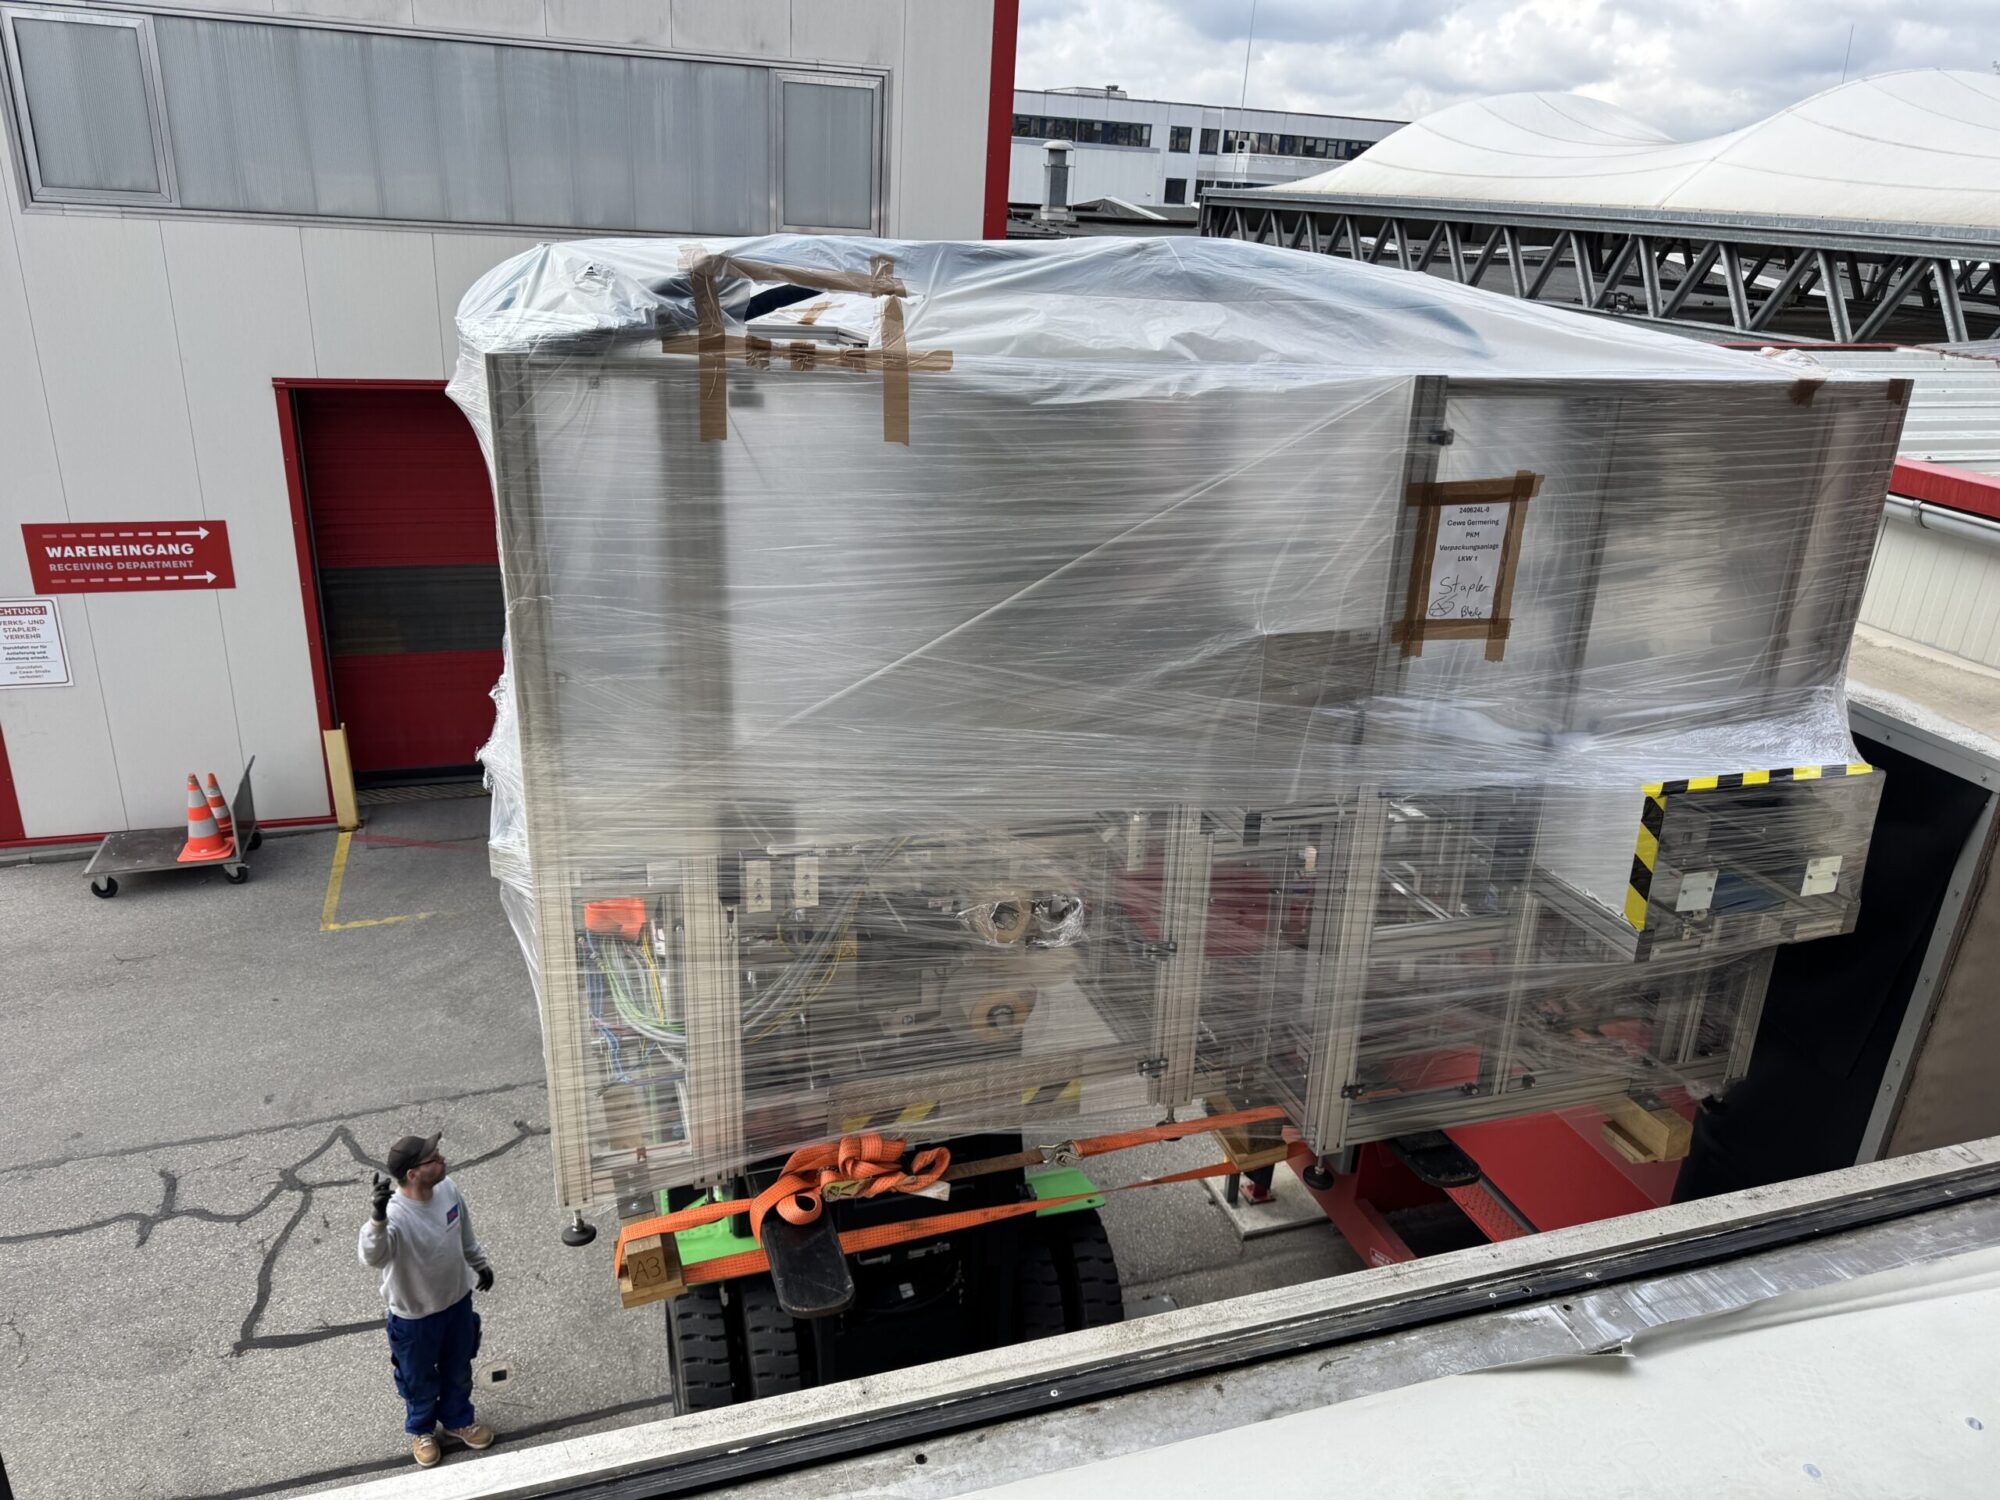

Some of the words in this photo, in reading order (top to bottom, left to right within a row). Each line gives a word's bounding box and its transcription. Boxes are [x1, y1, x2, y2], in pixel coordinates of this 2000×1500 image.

[45, 543, 195, 558] WARENEINGANG
[49, 562, 114, 572] RECEIVING
[117, 560, 194, 570] DEPARTMENT
[1438, 574, 1490, 599] Stapler
[0, 607, 46, 615] CHTUNG!
[633, 1256, 662, 1284] A3
